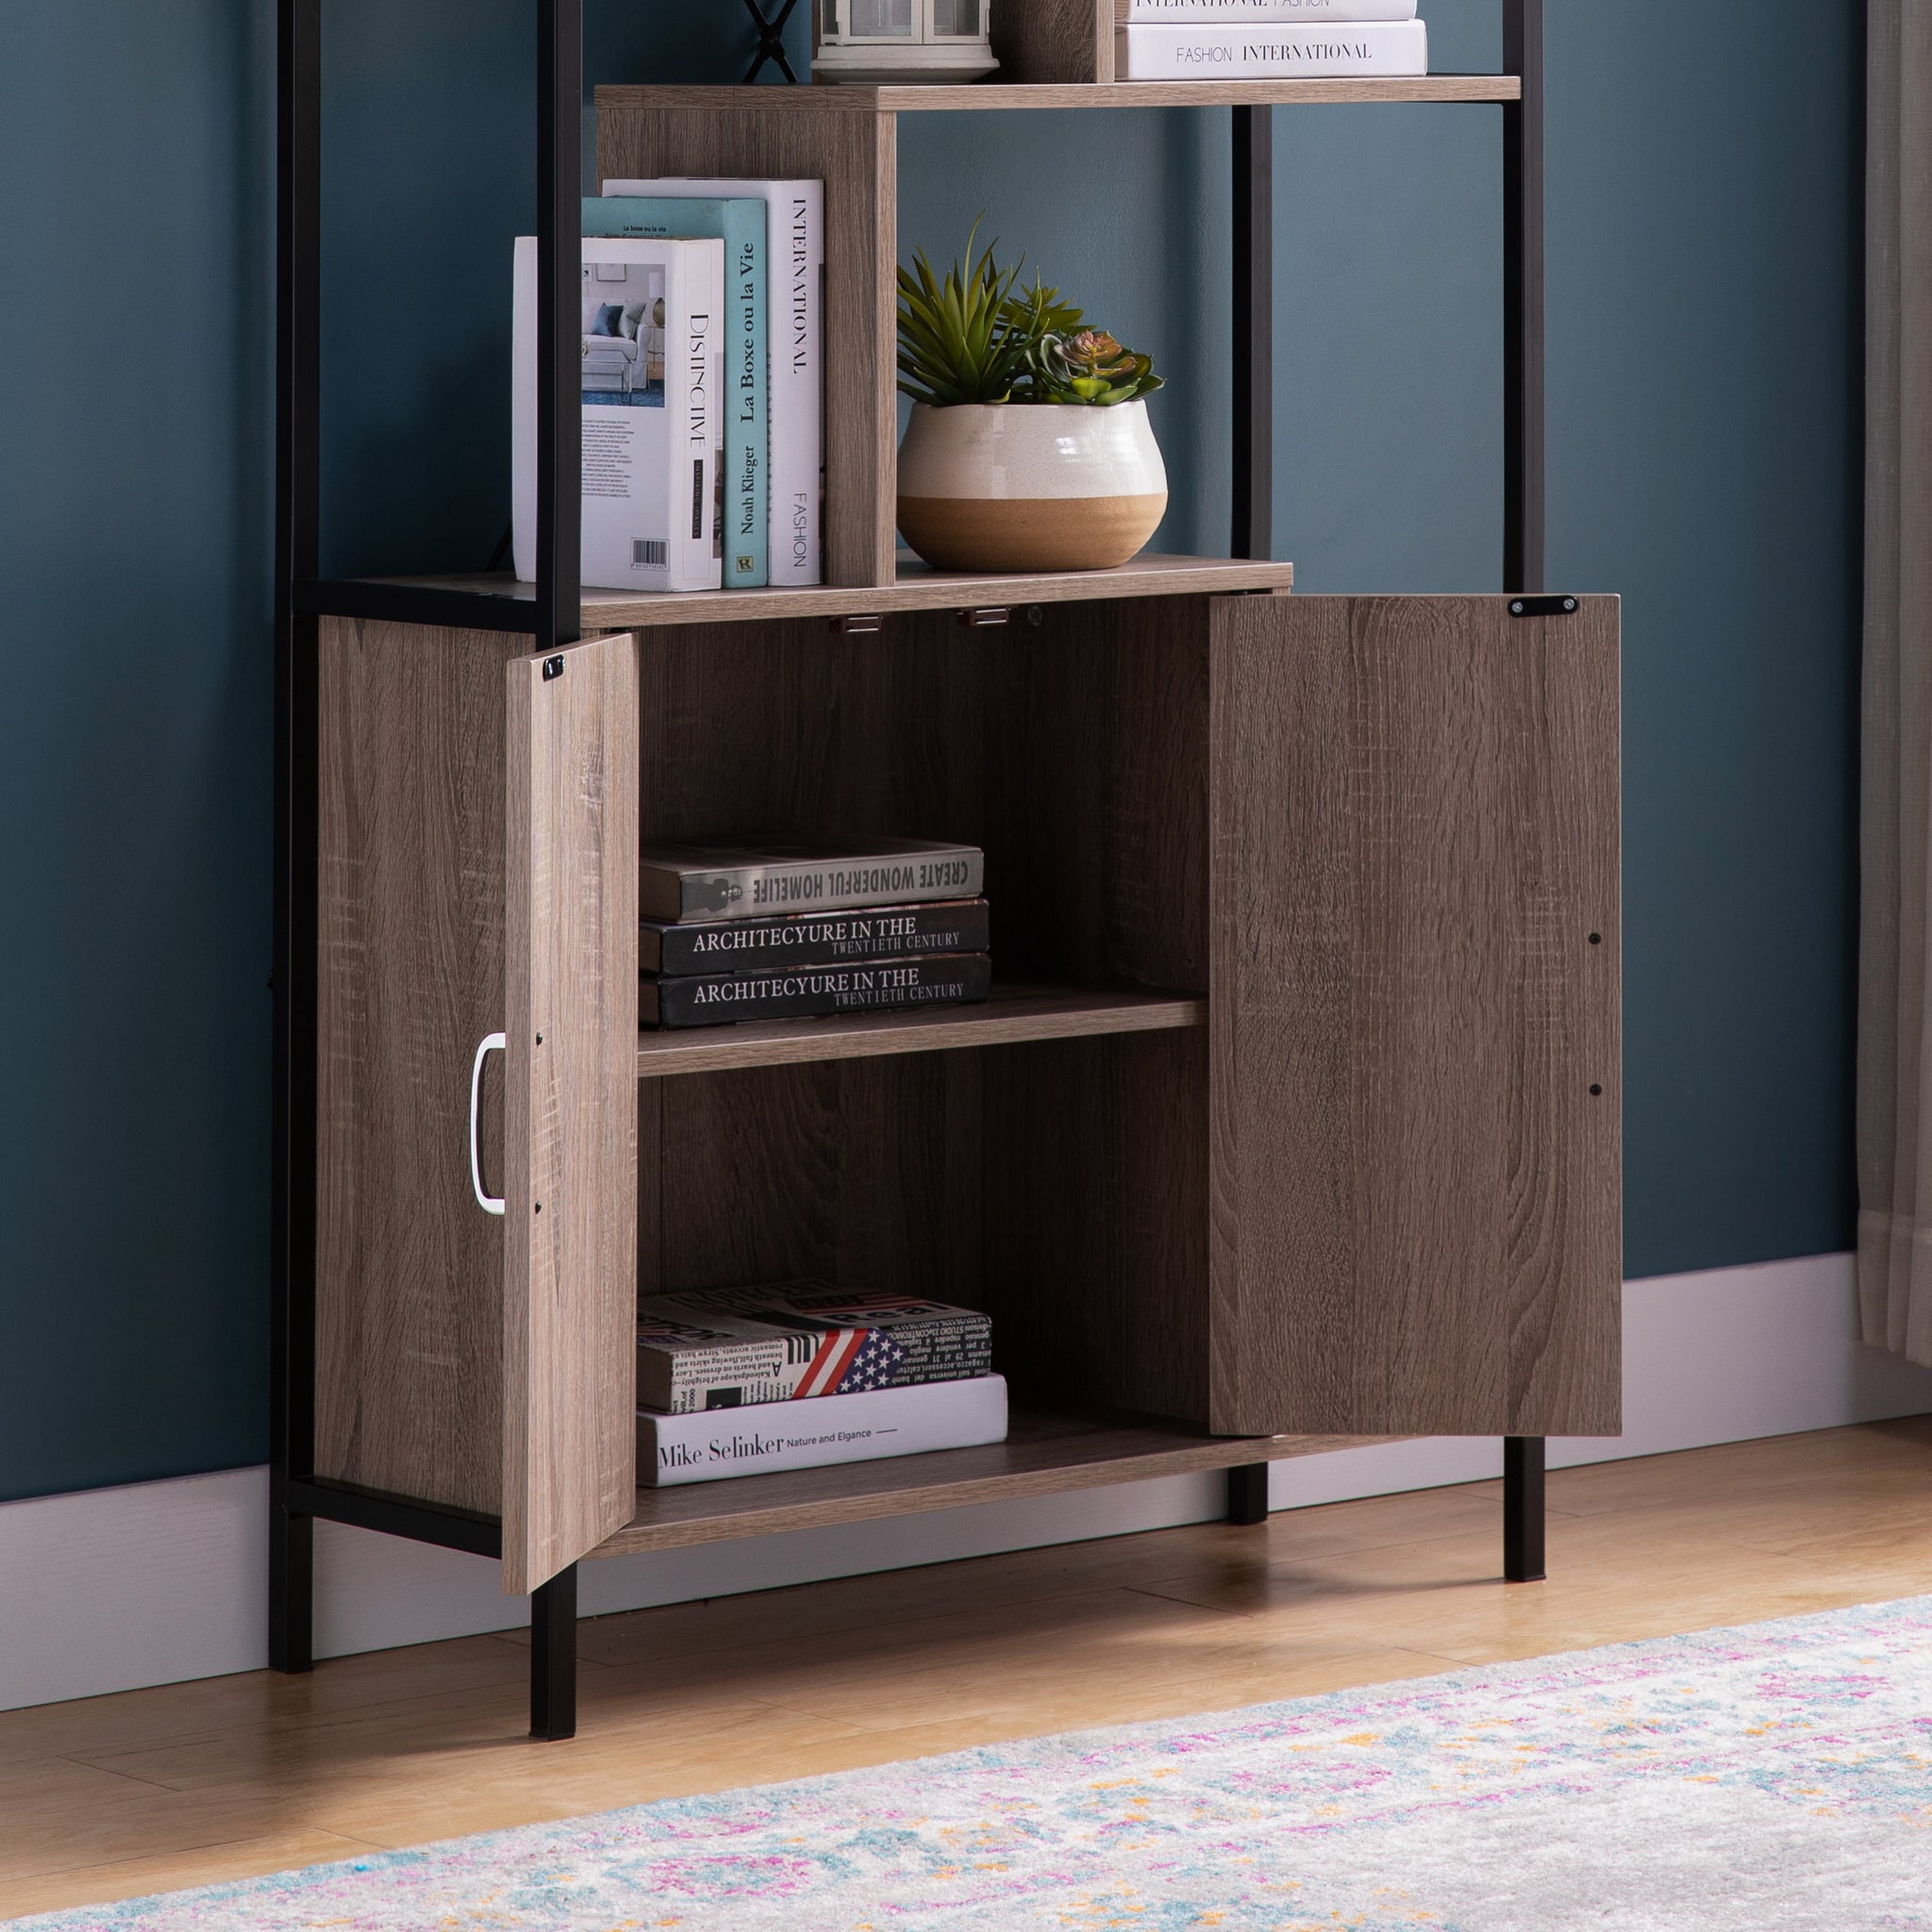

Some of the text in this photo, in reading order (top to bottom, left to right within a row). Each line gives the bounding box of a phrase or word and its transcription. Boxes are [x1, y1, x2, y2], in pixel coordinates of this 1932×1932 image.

[1176, 43, 1373, 62] FASHION INTERNATIONAL
[792, 199, 808, 375] INTERNATIONAL
[740, 242, 755, 423] La Boxe ou la Vie
[690, 314, 709, 448] DISTINCTIVE
[741, 445, 758, 535] Noah Klieger
[792, 492, 808, 568] FASHION
[753, 860, 968, 903] CREATE WONDERFUL HOMELIFE
[692, 917, 916, 952] ARCHITECYURE IN THE
[832, 931, 960, 955] TWENTIETH CENTURY
[693, 968, 919, 1004] ARCHITECYURE IN THE
[834, 982, 964, 1007] TWENTIETH CENTURY
[772, 1361, 782, 1376] A
[658, 1429, 872, 1469] Mike Selinker Nature and Elgance
